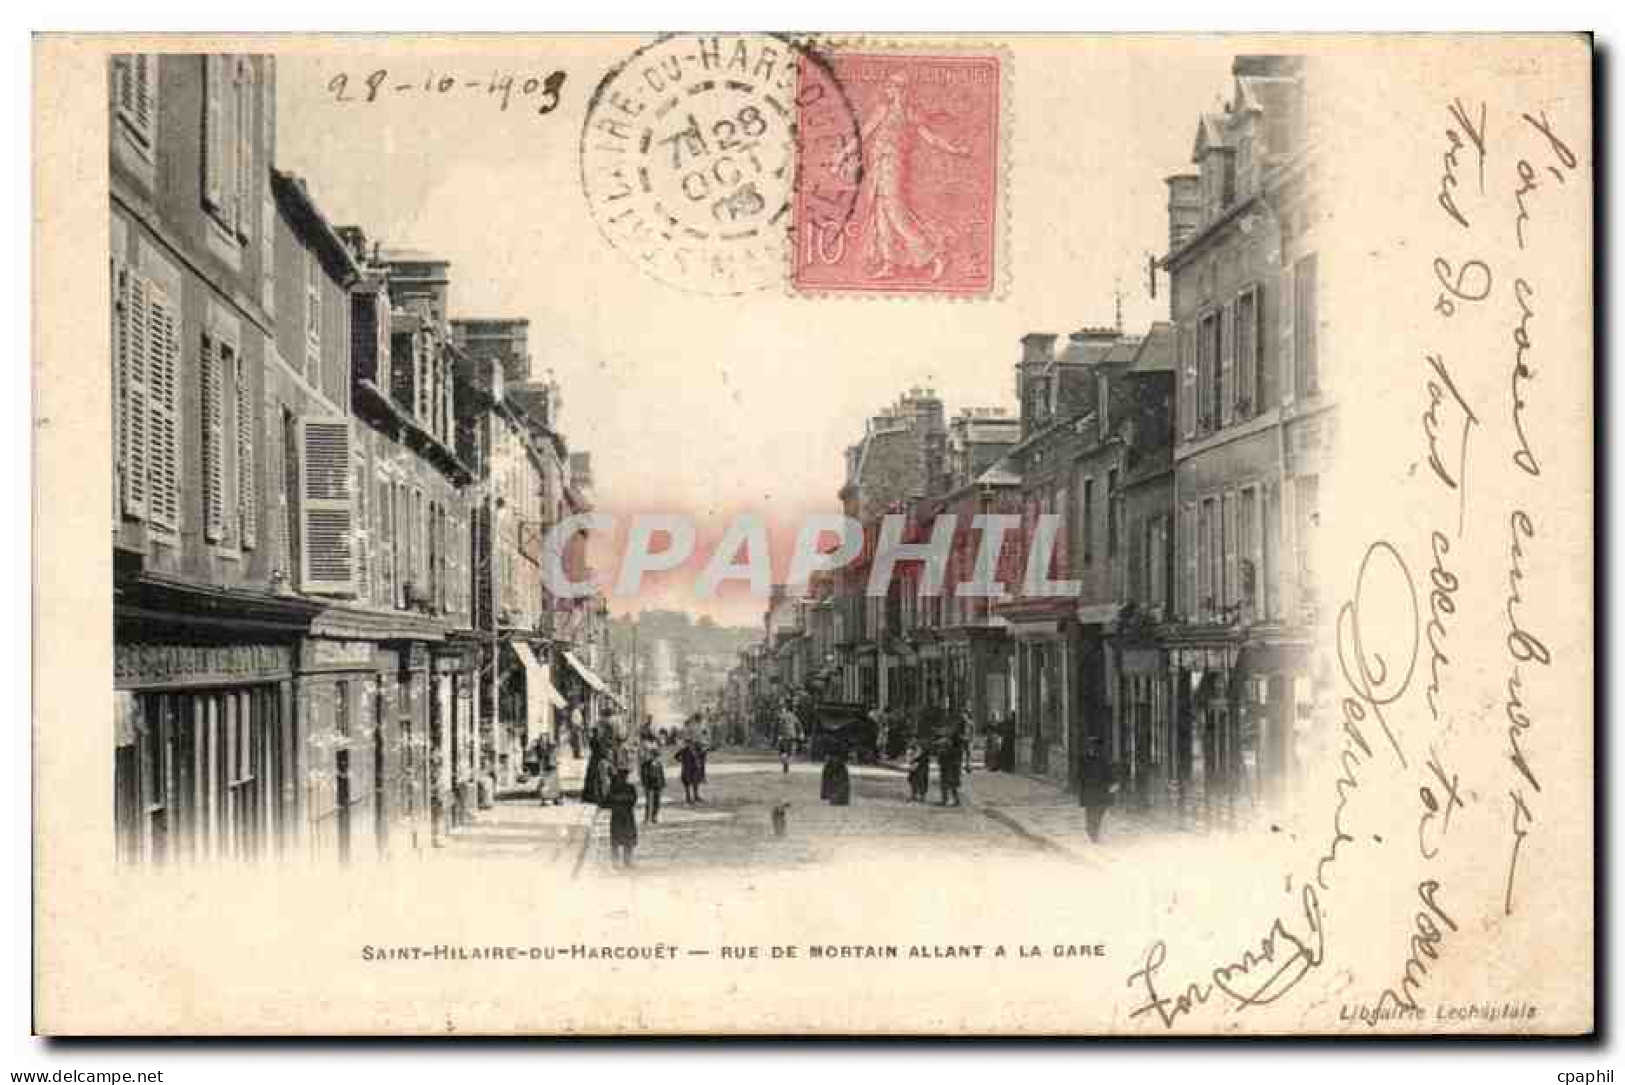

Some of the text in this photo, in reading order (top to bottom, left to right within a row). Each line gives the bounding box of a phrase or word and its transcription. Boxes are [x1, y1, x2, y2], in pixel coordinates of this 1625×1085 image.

[720, 945, 759, 959] RUE
[771, 945, 797, 959] DE
[809, 945, 898, 959] MORTAIN
[908, 945, 983, 959] ALLANT
[993, 945, 1007, 958] A
[1019, 945, 1042, 958] LA
[1053, 945, 1107, 958] GARE
